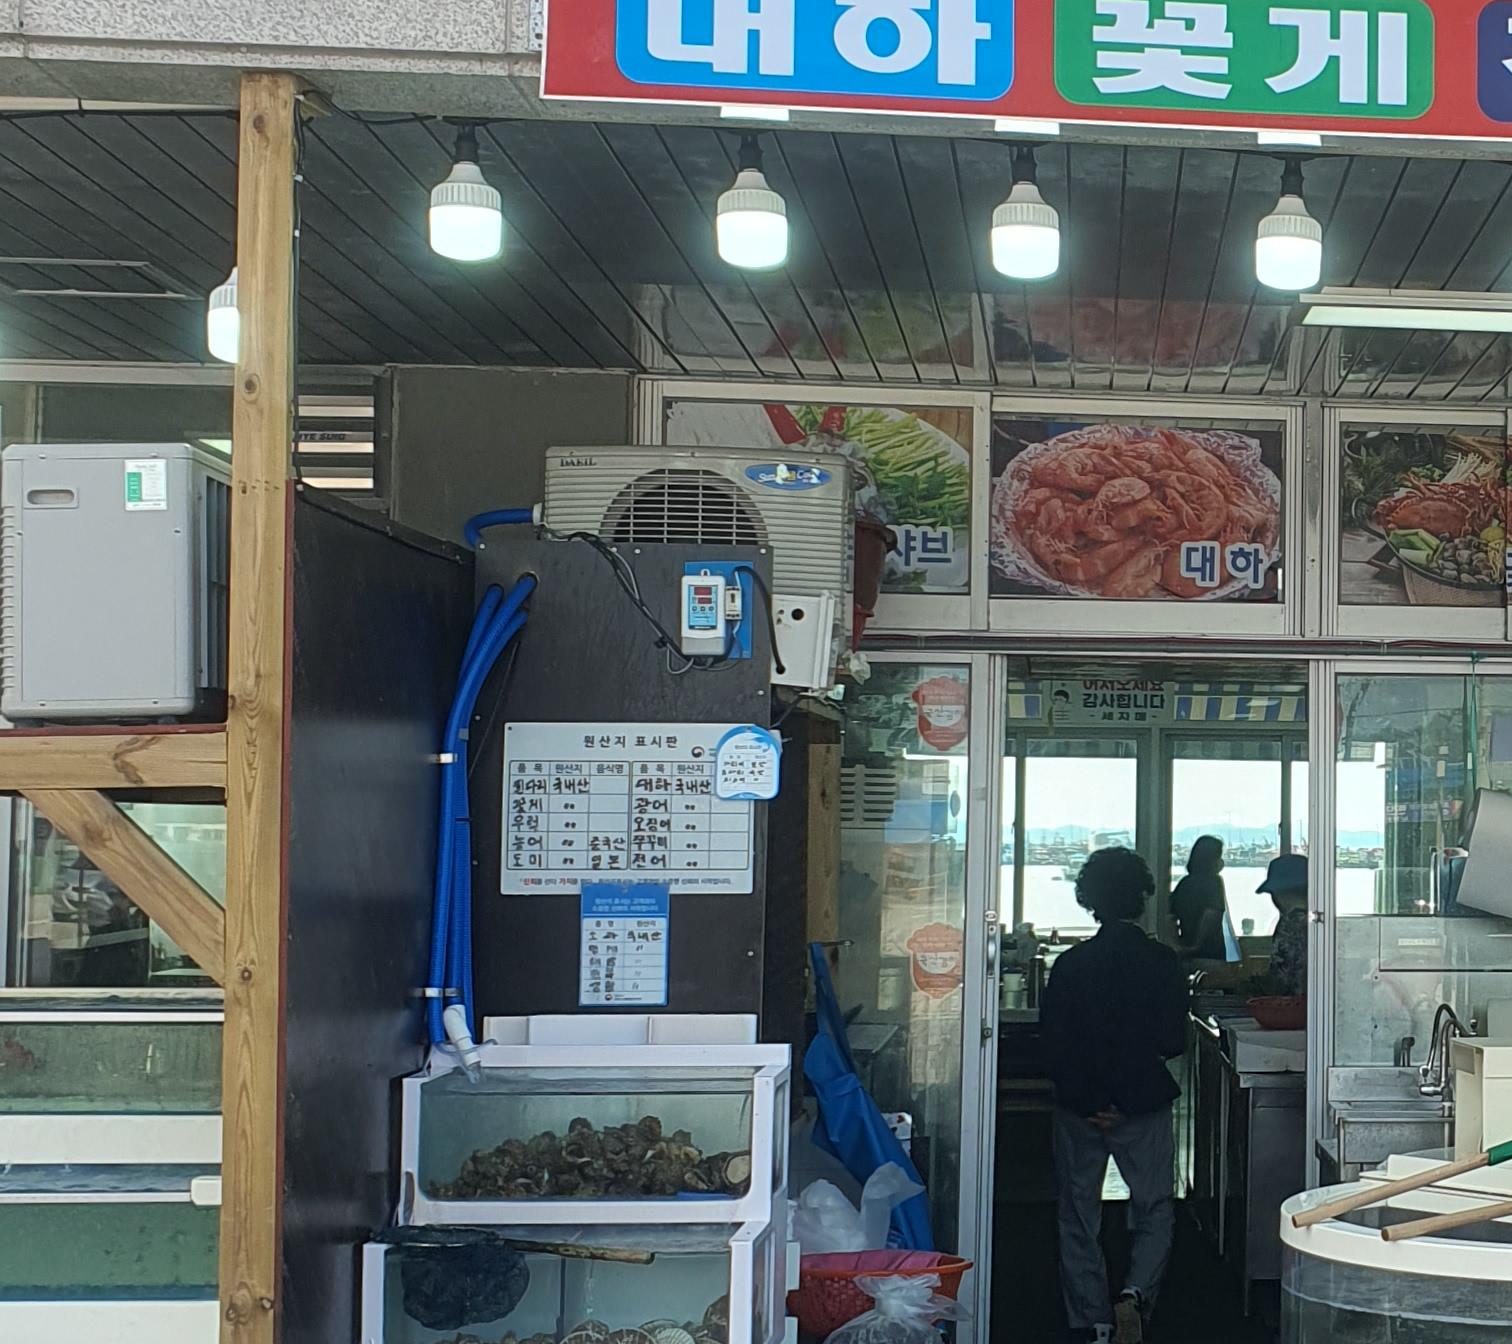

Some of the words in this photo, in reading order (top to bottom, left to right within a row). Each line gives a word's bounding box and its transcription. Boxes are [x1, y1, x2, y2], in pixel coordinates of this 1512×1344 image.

[1185, 545, 1264, 585] 대하
[1083, 693, 1165, 709] 감사합니다
[584, 735, 626, 748] 원산지
[634, 735, 678, 749] 표시판
[553, 777, 590, 794] 국내산
[675, 778, 712, 795] 국내산
